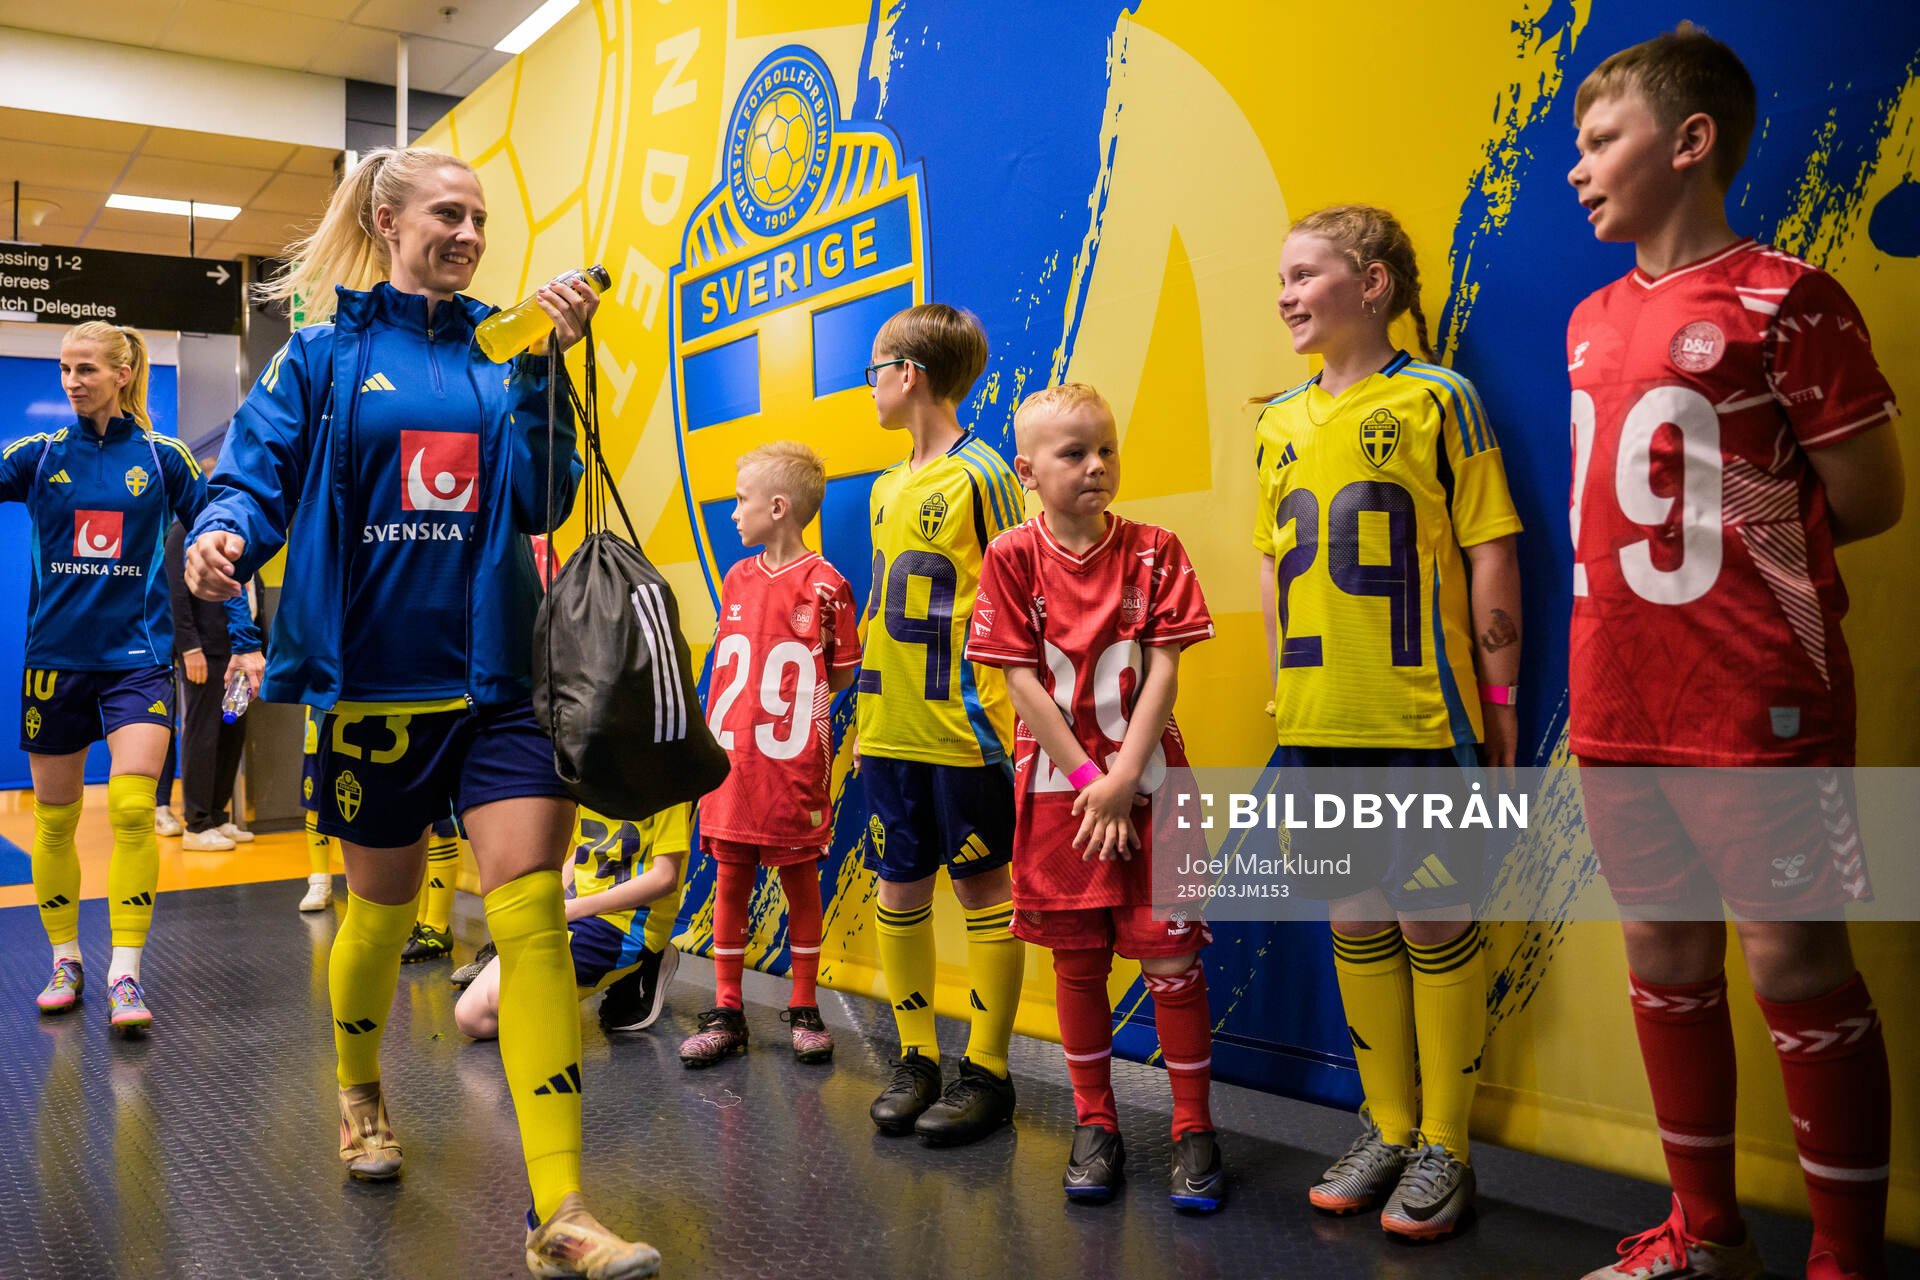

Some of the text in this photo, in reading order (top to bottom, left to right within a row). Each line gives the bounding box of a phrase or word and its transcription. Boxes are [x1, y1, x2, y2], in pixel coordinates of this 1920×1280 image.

[733, 67, 828, 220] SVENSKA FOTBOLLFÖRBUNDET
[596, 0, 701, 418] NDET
[765, 205, 797, 230] 1904
[55, 254, 82, 271] 1-2
[701, 217, 878, 324] SVERIGE
[0, 296, 117, 318] tch Delegates
[362, 522, 463, 543] SVENSKA
[50, 562, 142, 577] SVENSKA SPEL
[1276, 481, 1423, 669] 29
[708, 634, 817, 760] 29
[332, 713, 412, 764] 23
